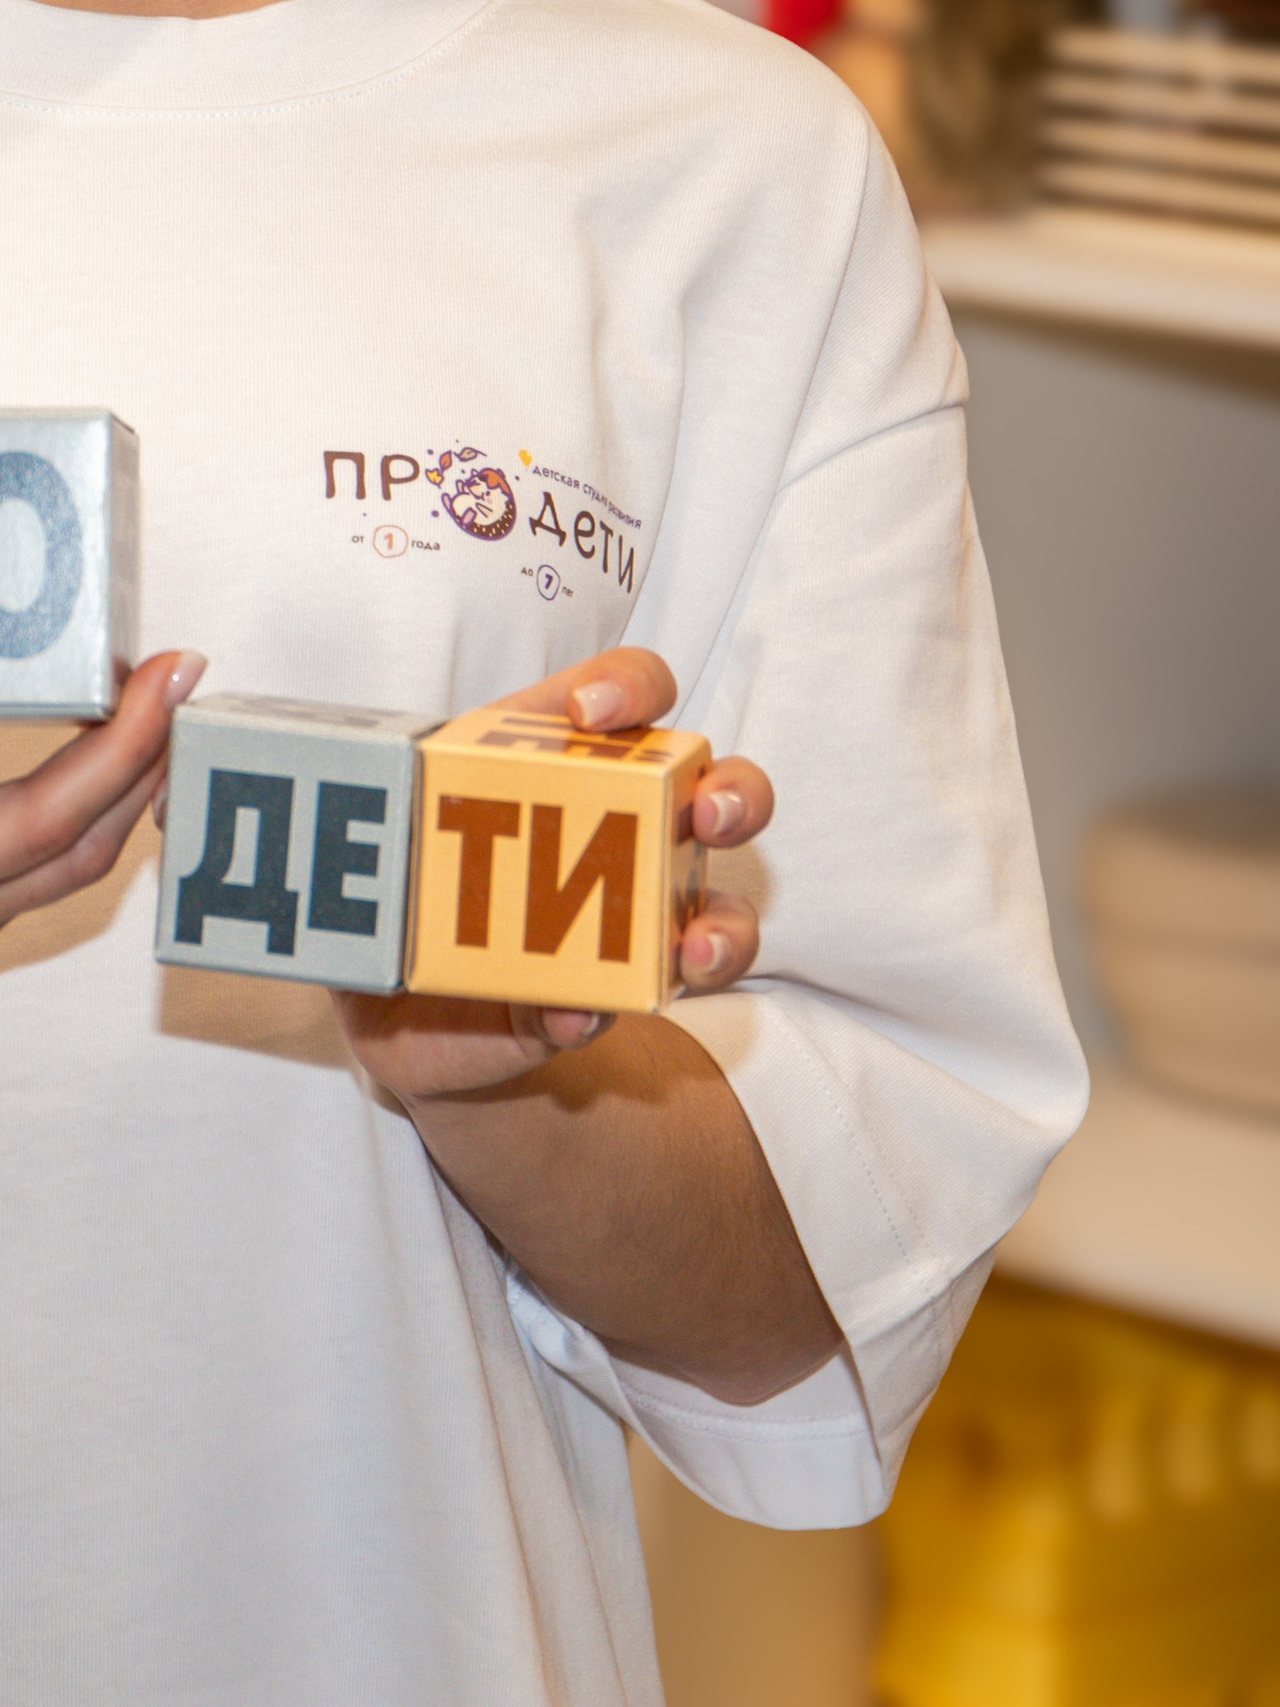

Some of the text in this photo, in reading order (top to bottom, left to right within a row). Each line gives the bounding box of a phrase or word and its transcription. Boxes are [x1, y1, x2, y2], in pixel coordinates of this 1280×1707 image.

[532, 465, 580, 490] детская
[351, 532, 441, 552] от 1 года
[545, 573, 554, 590] 7
